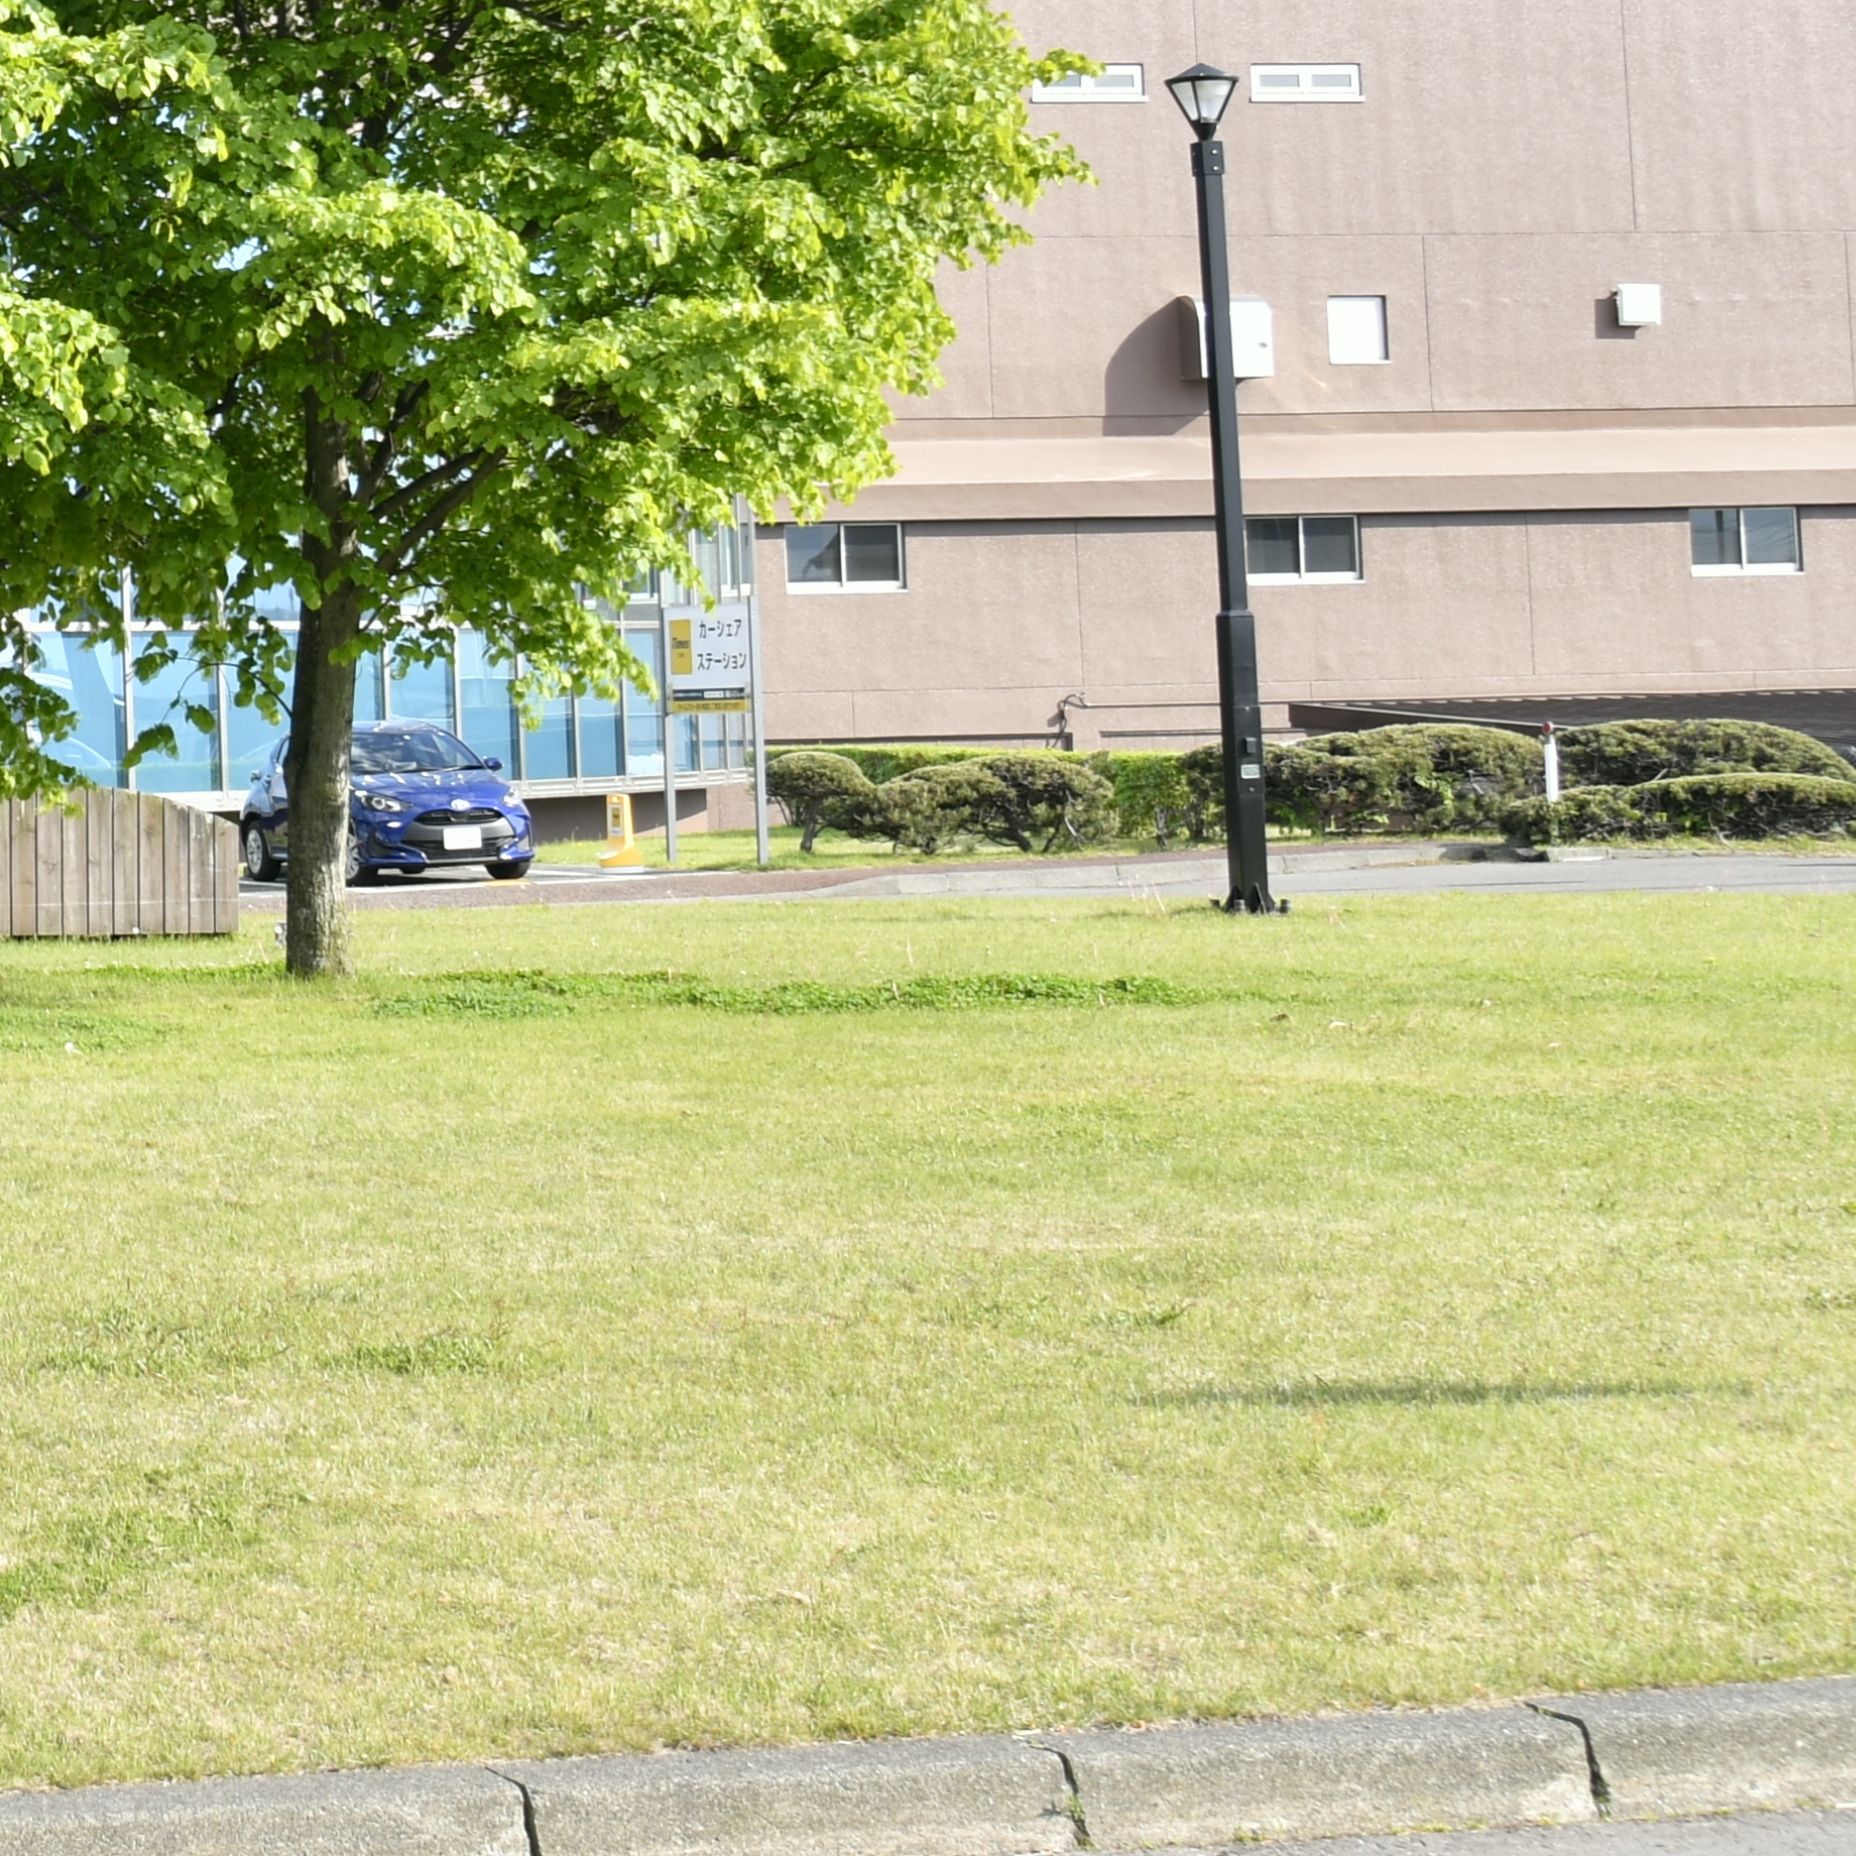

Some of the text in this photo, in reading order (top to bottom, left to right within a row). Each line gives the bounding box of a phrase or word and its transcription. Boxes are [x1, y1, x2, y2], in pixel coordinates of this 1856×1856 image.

[699, 618, 742, 639] カーシェア
[697, 652, 747, 671] ステーション
